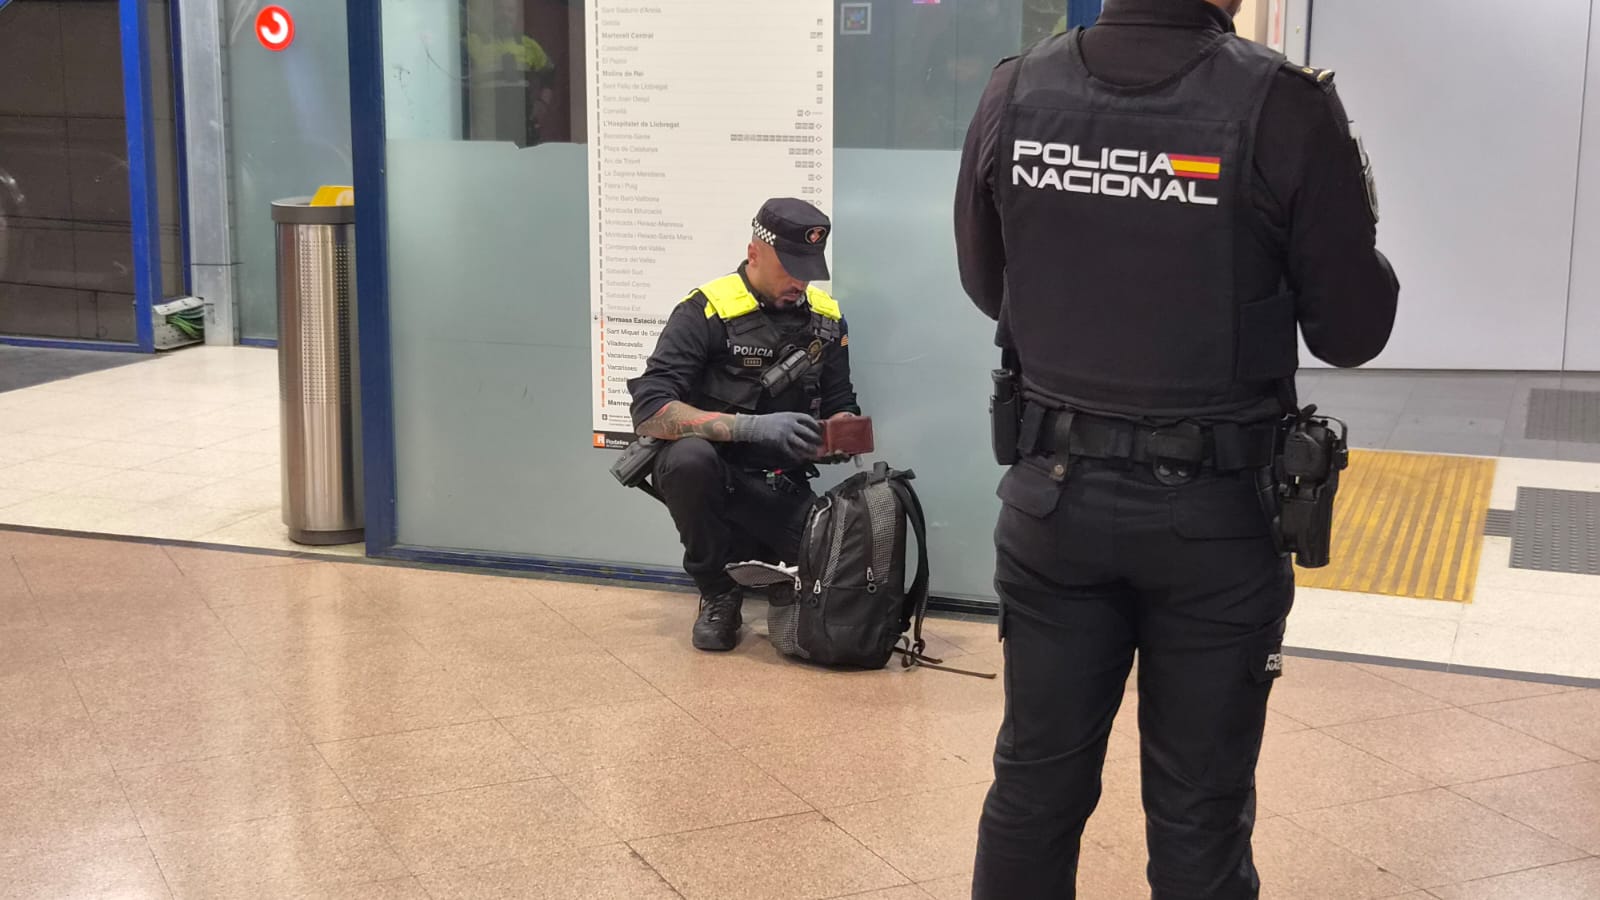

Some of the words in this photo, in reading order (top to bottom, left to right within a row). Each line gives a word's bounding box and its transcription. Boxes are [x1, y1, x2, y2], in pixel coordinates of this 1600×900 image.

[604, 120, 640, 129] L'Hospitalet
[650, 121, 680, 130] Llobregat
[1012, 164, 1218, 206] NACIONAL
[733, 345, 774, 358] POLICIA
